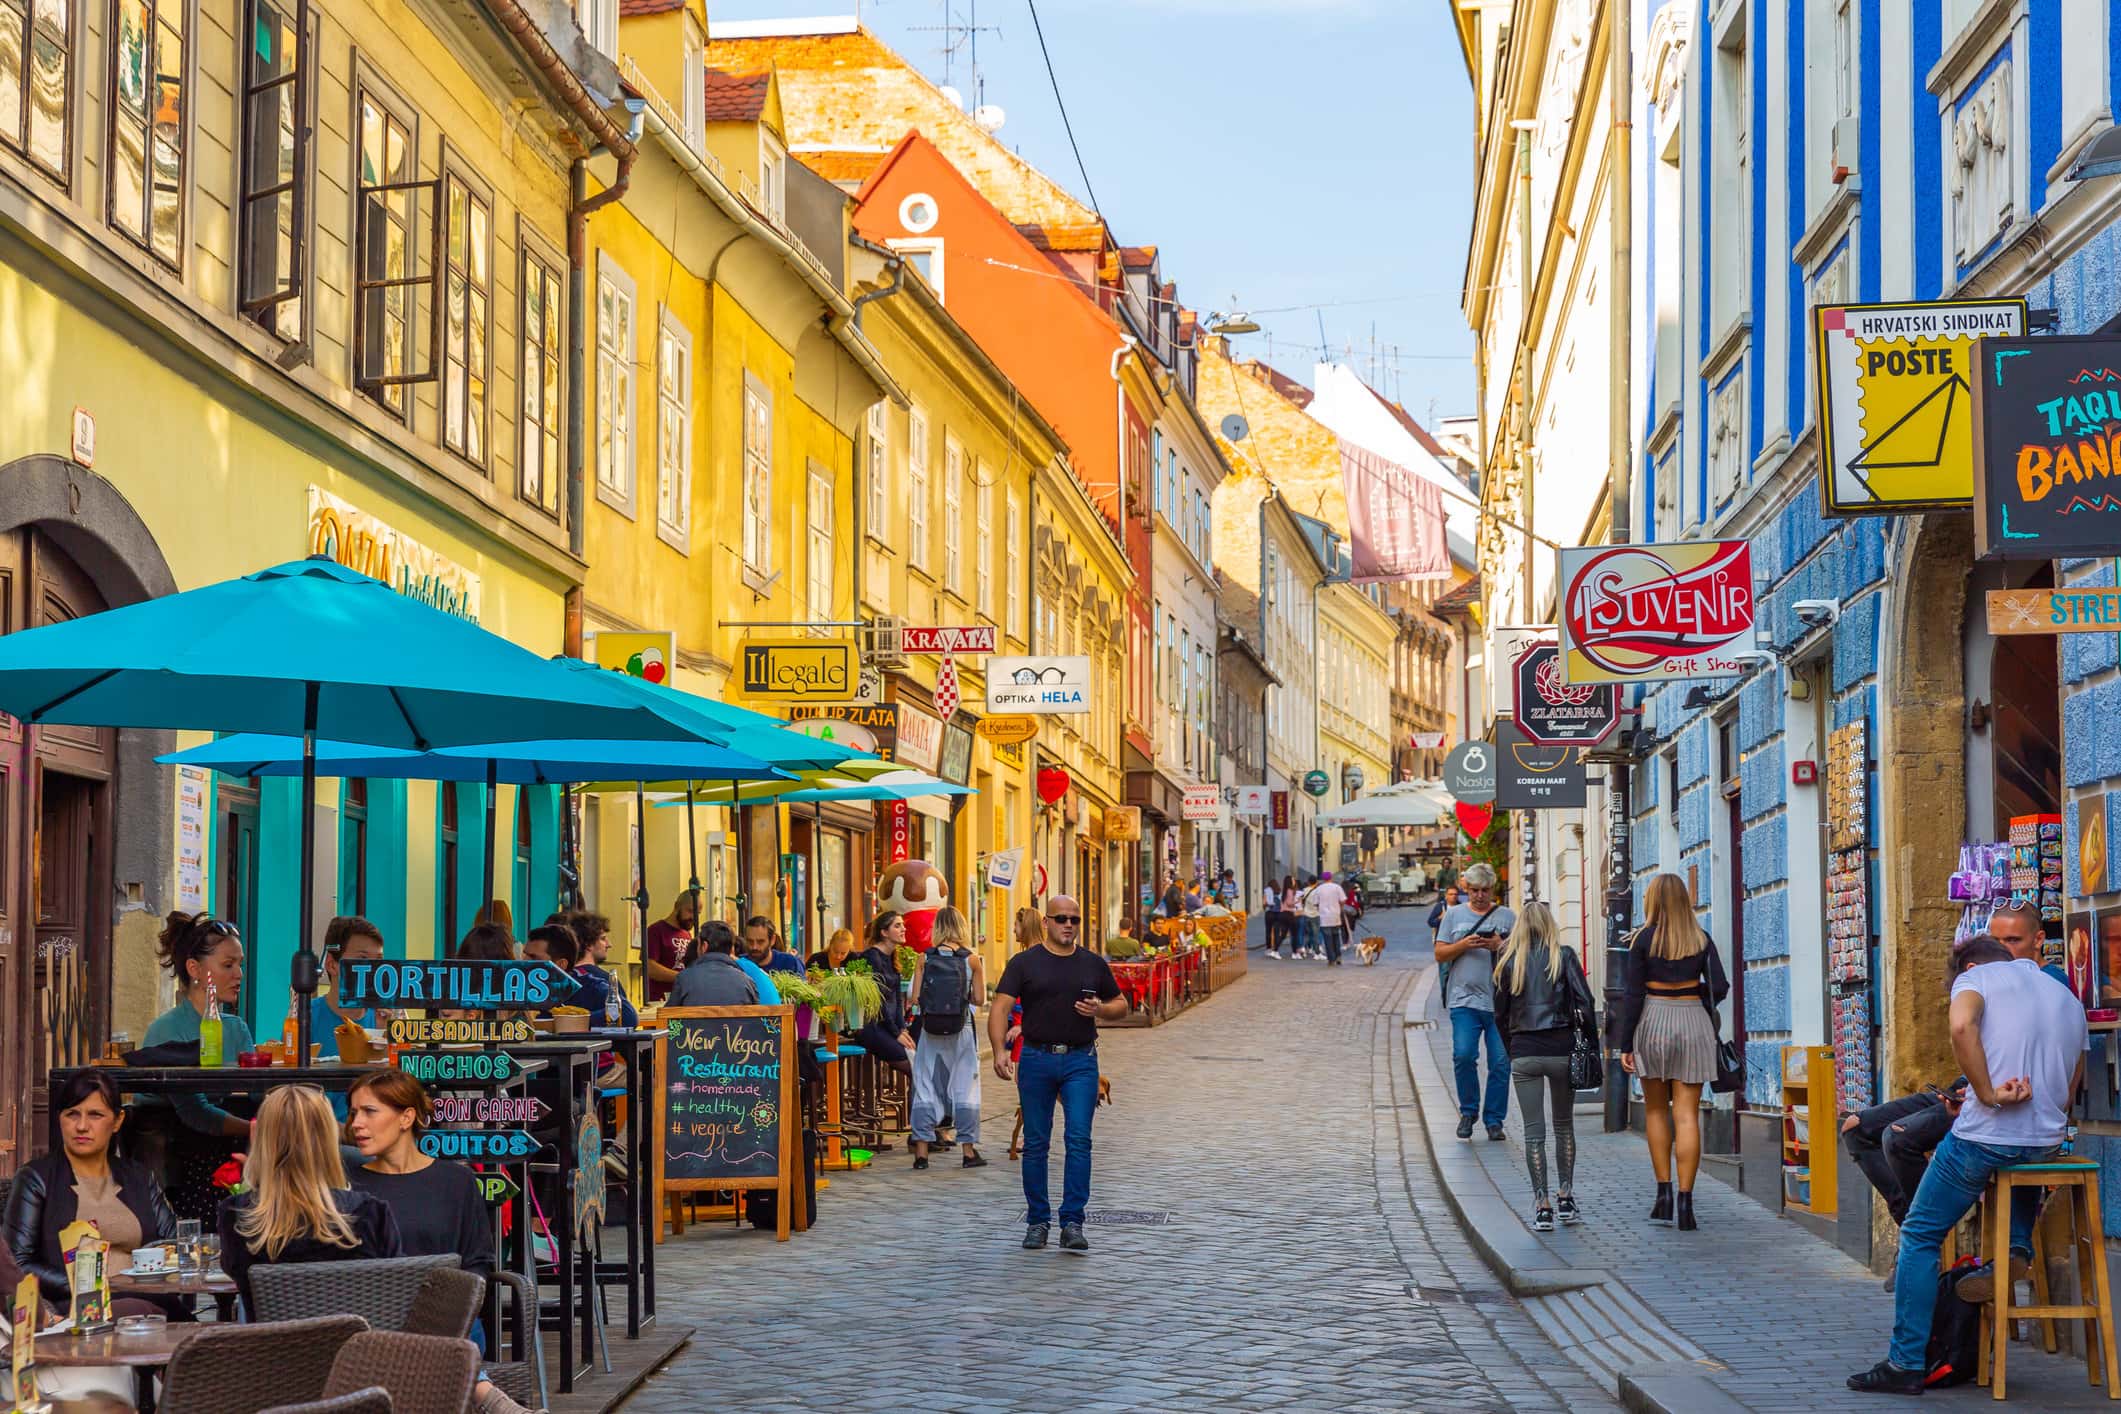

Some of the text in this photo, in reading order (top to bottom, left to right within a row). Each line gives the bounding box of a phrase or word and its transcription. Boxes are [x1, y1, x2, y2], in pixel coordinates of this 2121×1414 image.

[1862, 312, 2013, 334] HRVATSKI SINDIKAT
[1867, 341, 1953, 377] POŠTE
[2050, 594, 2121, 625] STRE
[903, 628, 993, 650] KRAVATA
[1664, 659, 1698, 677] Gift
[995, 690, 1082, 704] OPTIKA HELA
[848, 707, 896, 727] ZLATA
[1530, 706, 1606, 719] ZLATARNA
[1516, 777, 1566, 785] KOREAN MART
[895, 803, 906, 860] CROA
[351, 963, 550, 1003] TORTILLAS
[390, 1019, 529, 1044] QUESADILLAS
[676, 1024, 776, 1065] New Vegan
[401, 1055, 511, 1081] NACHOS
[677, 1052, 782, 1081] Restaurant
[432, 1097, 540, 1122] CON CARNE
